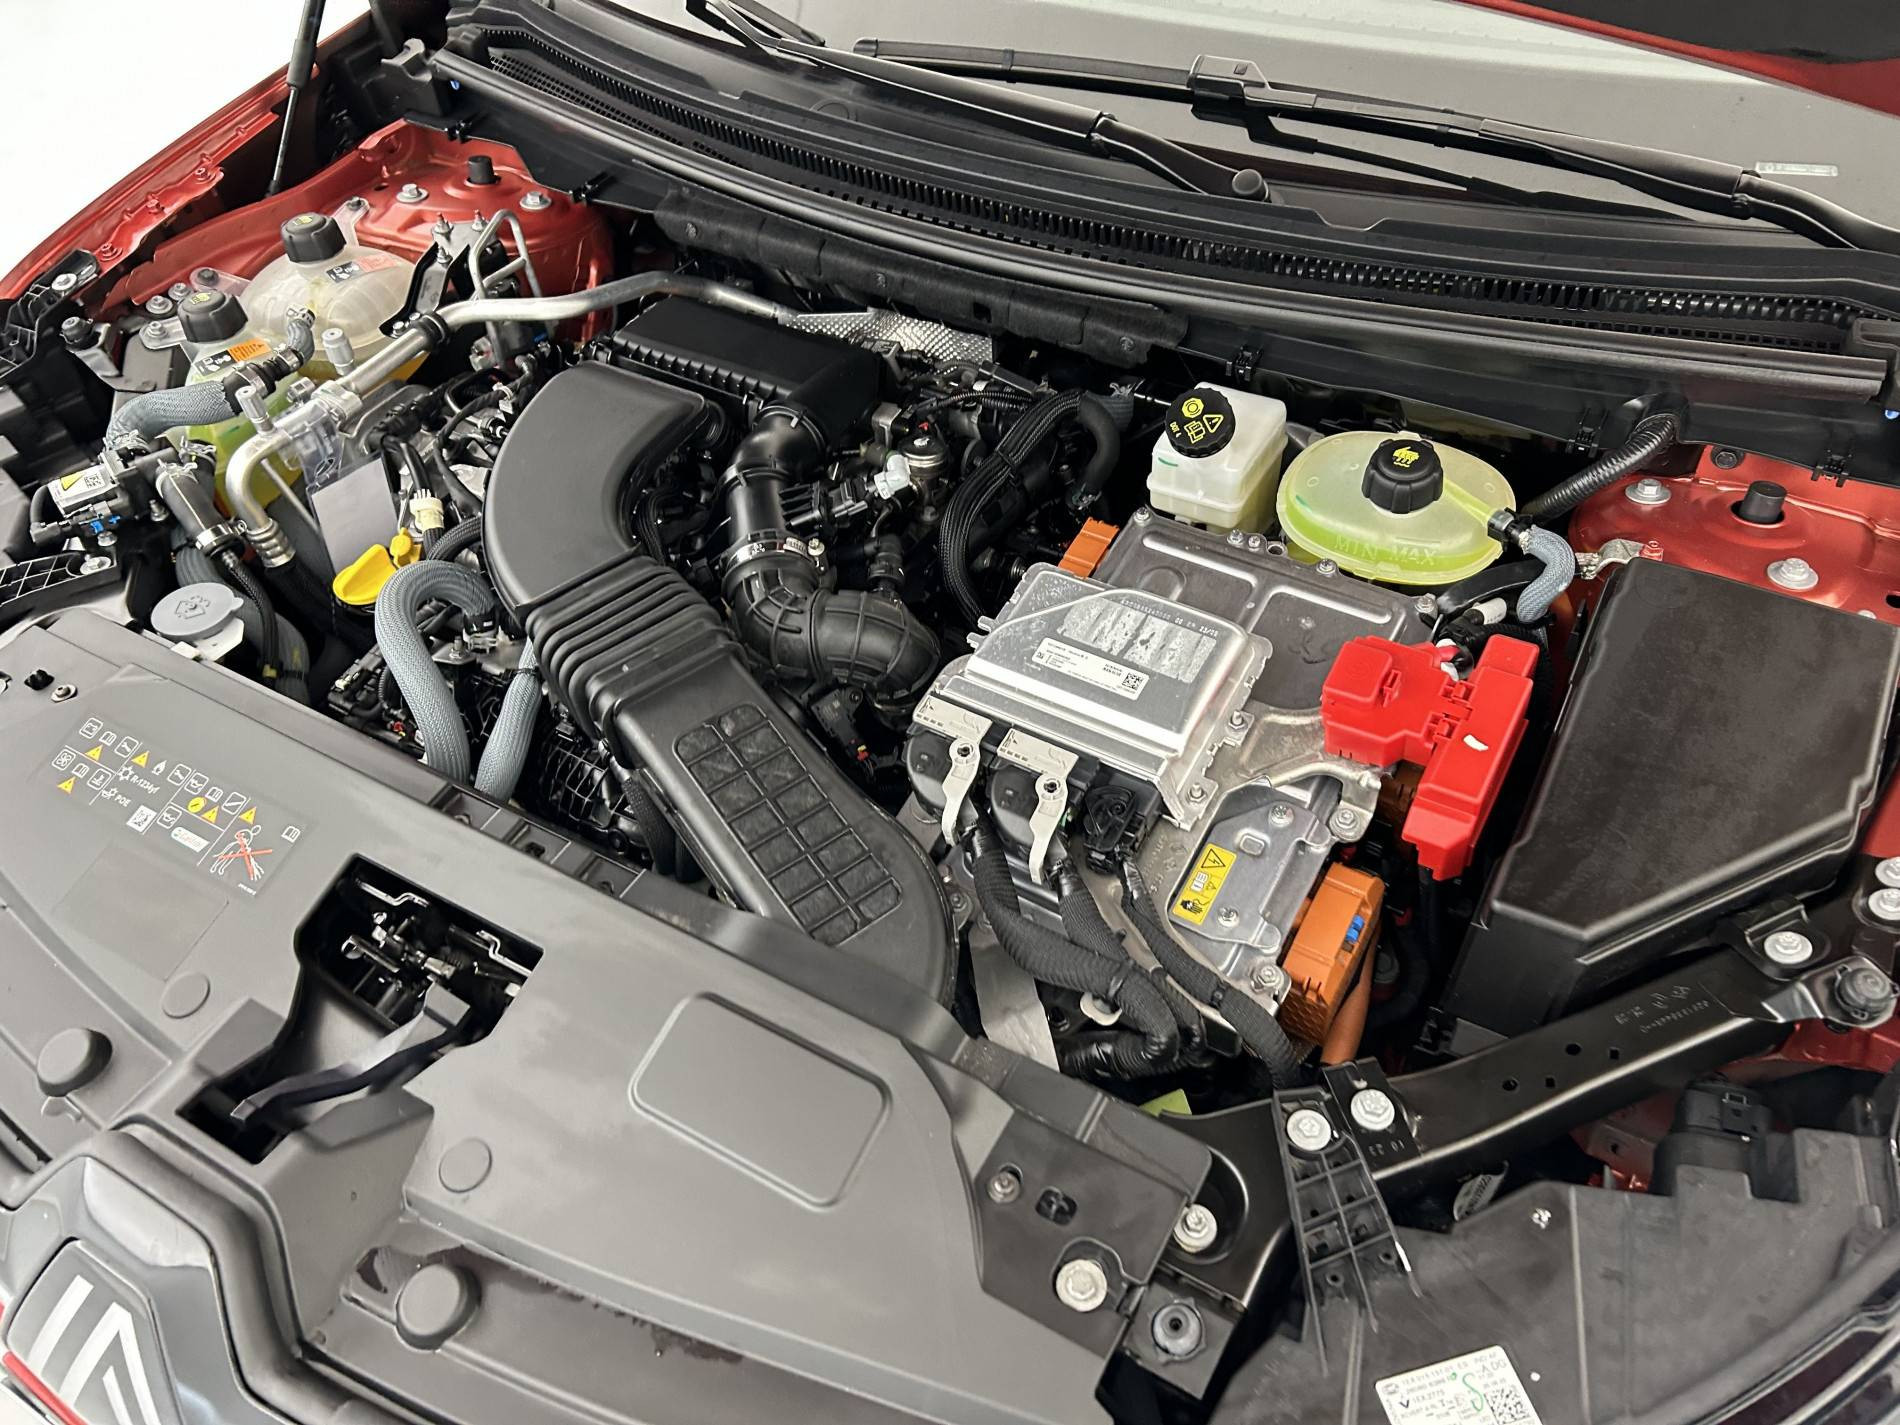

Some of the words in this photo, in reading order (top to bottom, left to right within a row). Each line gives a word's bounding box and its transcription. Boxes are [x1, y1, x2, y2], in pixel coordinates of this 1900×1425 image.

[1334, 535, 1378, 560] MIN
[1389, 545, 1437, 566] MAX
[114, 793, 131, 807] POE
